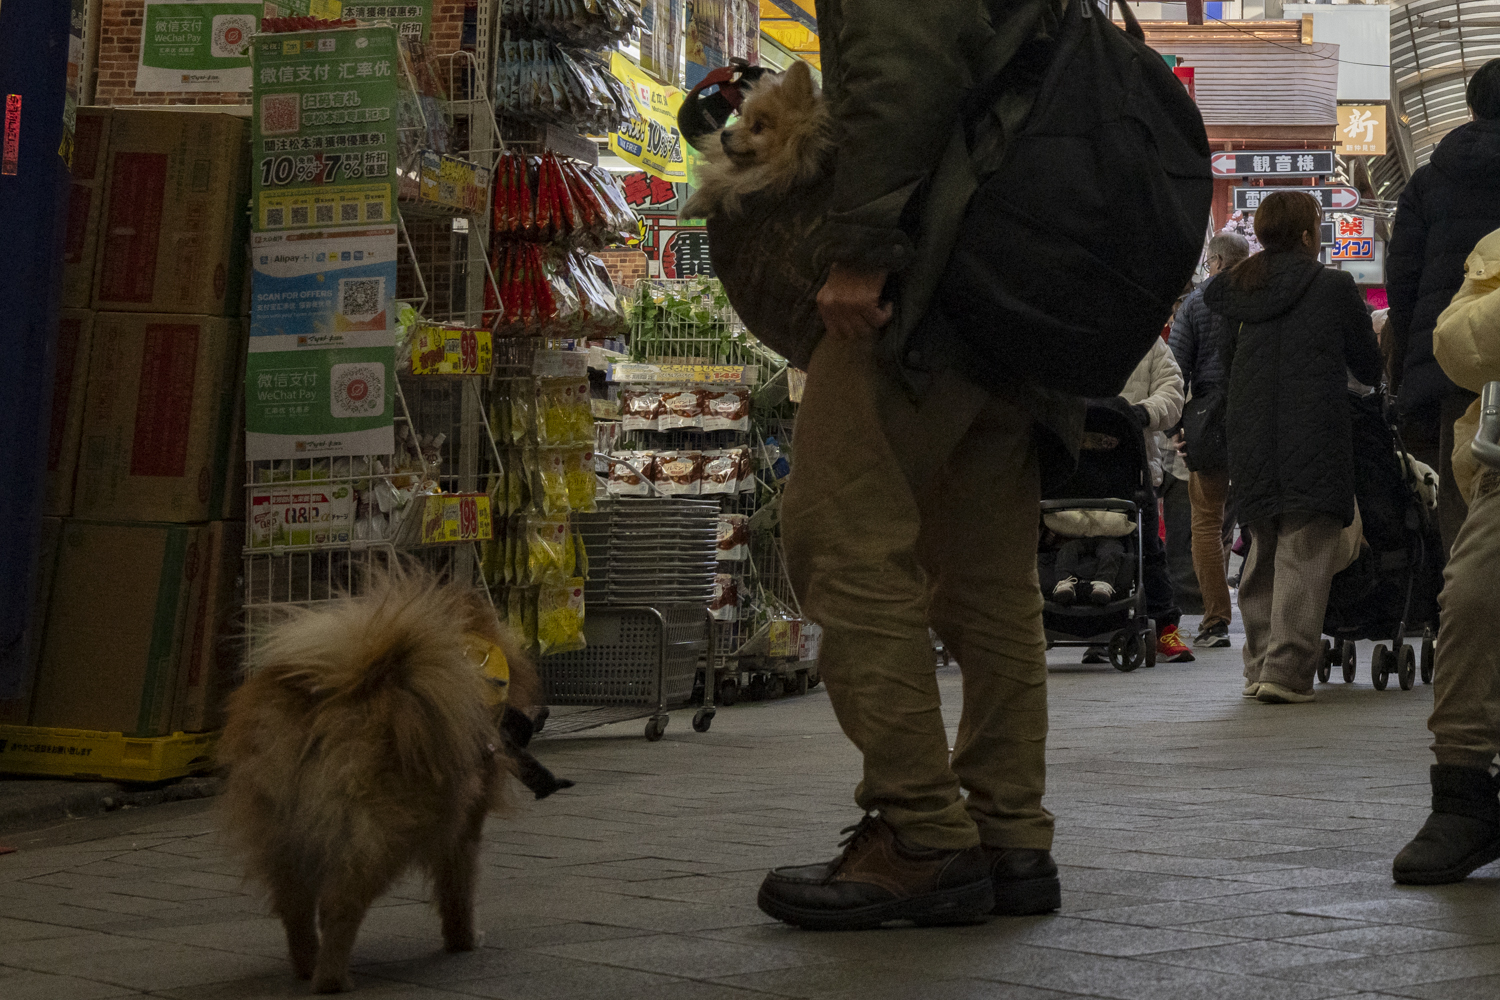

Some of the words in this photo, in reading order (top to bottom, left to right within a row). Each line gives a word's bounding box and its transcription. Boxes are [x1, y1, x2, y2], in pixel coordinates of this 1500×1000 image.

[155, 20, 202, 33] 微信支付
[154, 34, 186, 42] WeChat
[187, 34, 202, 43] Pay
[260, 64, 331, 84] 微信支付
[338, 60, 391, 79] 汇率优
[1343, 109, 1379, 142] 新
[1345, 144, 1376, 152] 新仲見世
[364, 151, 389, 164] 折扣
[1252, 155, 1315, 172] 観音様
[1332, 239, 1372, 256] ダイコク
[274, 254, 300, 264] Alipay
[257, 293, 280, 301] SCAN
[281, 292, 299, 300] FOR
[299, 289, 333, 299] OFFERS
[257, 371, 318, 388] 微信支付
[257, 389, 297, 401] WeChat
[300, 389, 317, 401] Pay
[460, 497, 479, 539] 198
